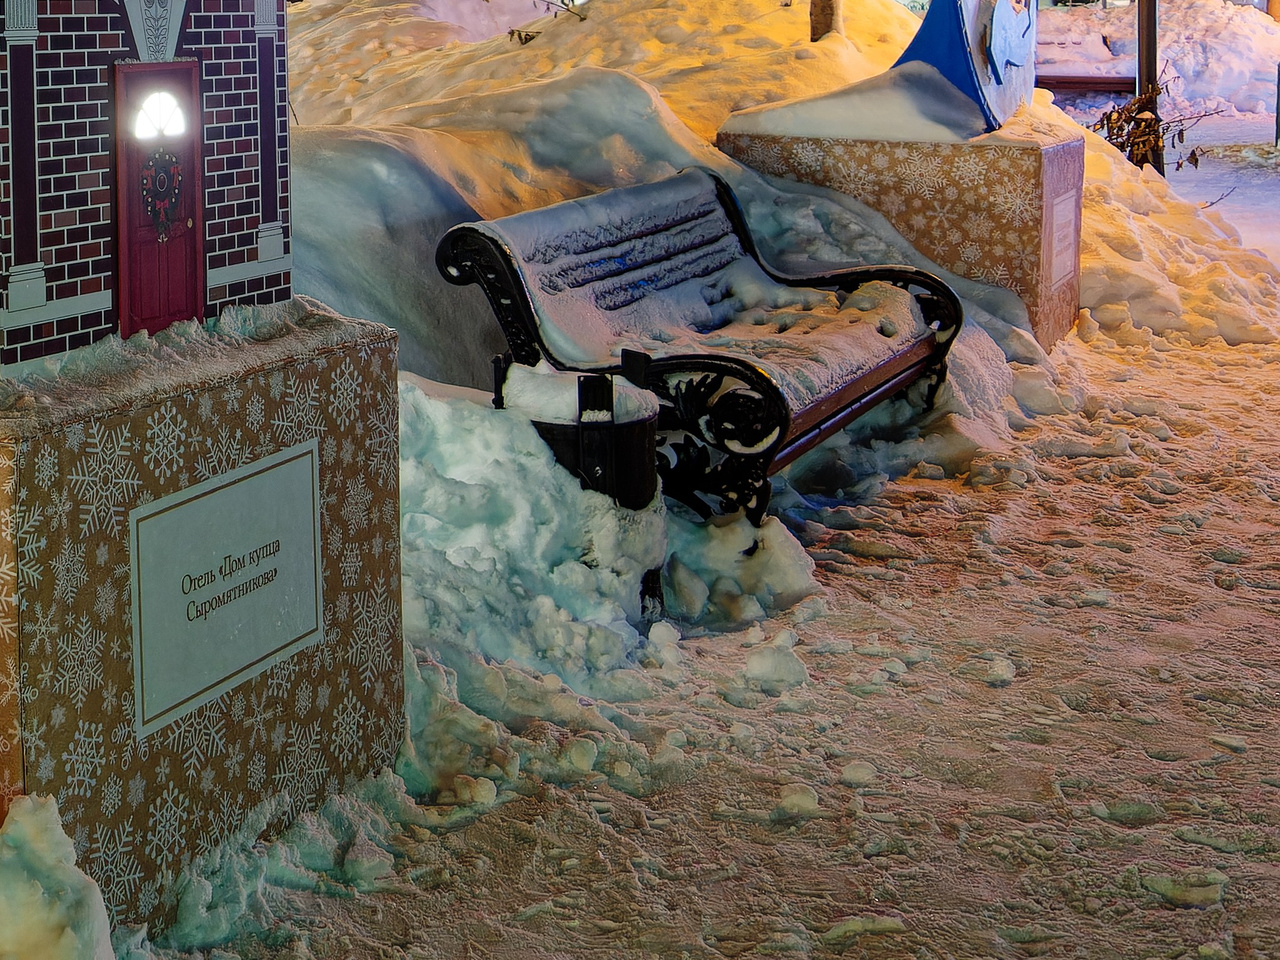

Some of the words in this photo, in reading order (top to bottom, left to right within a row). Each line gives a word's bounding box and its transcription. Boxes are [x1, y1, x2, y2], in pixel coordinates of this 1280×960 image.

[181, 569, 216, 595] Отель
[218, 554, 246, 581] «Дом
[248, 539, 281, 567] купца
[186, 567, 278, 622] Сыромятникова»
